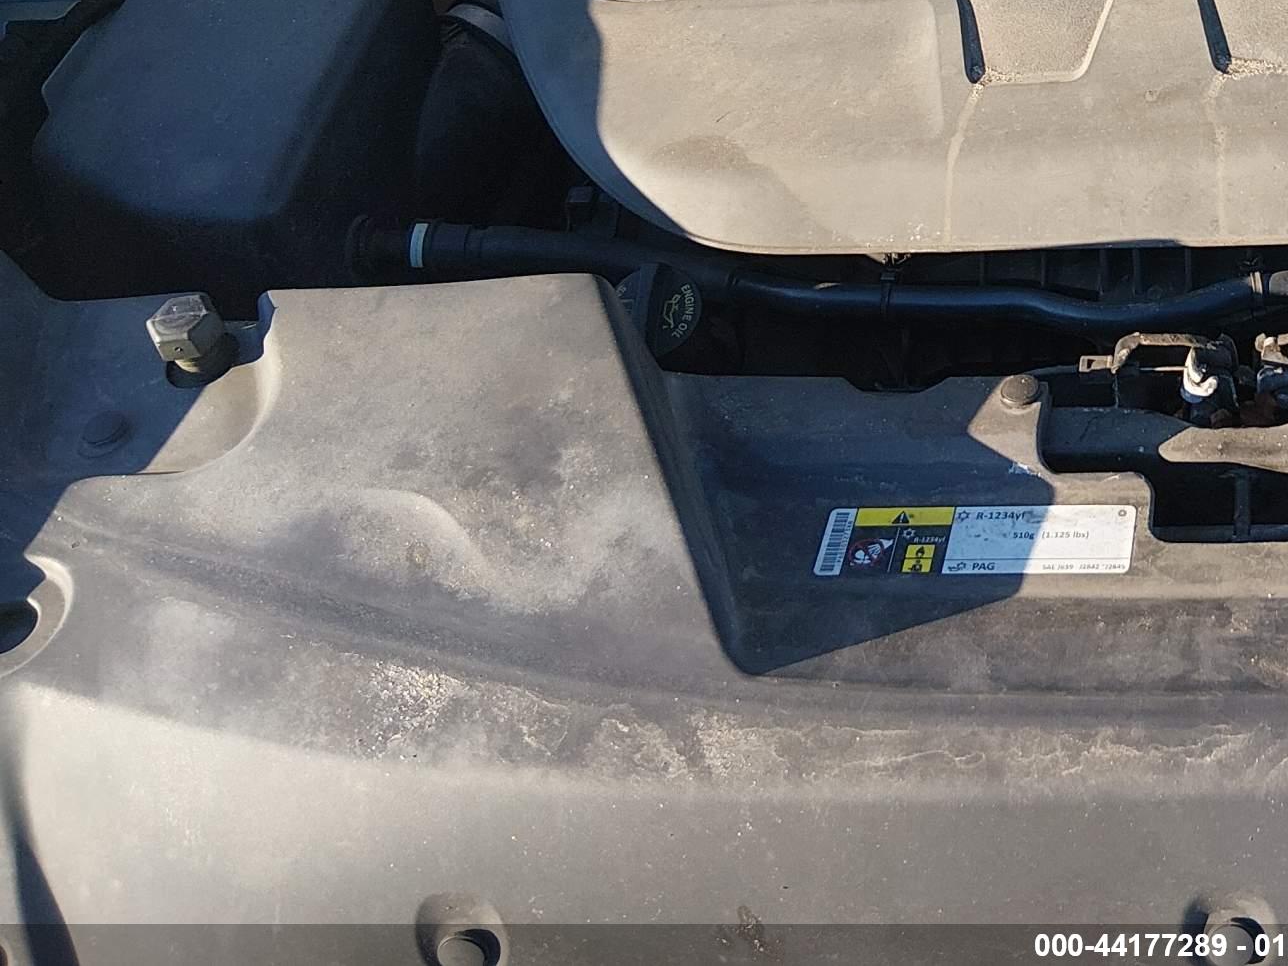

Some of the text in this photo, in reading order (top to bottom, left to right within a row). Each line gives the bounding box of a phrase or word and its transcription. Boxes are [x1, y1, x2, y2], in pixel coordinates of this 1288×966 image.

[672, 283, 695, 339] ENGINE OIL
[976, 510, 1026, 521] R-1234yf
[1013, 532, 1035, 540] 510g
[972, 562, 996, 571] PAG
